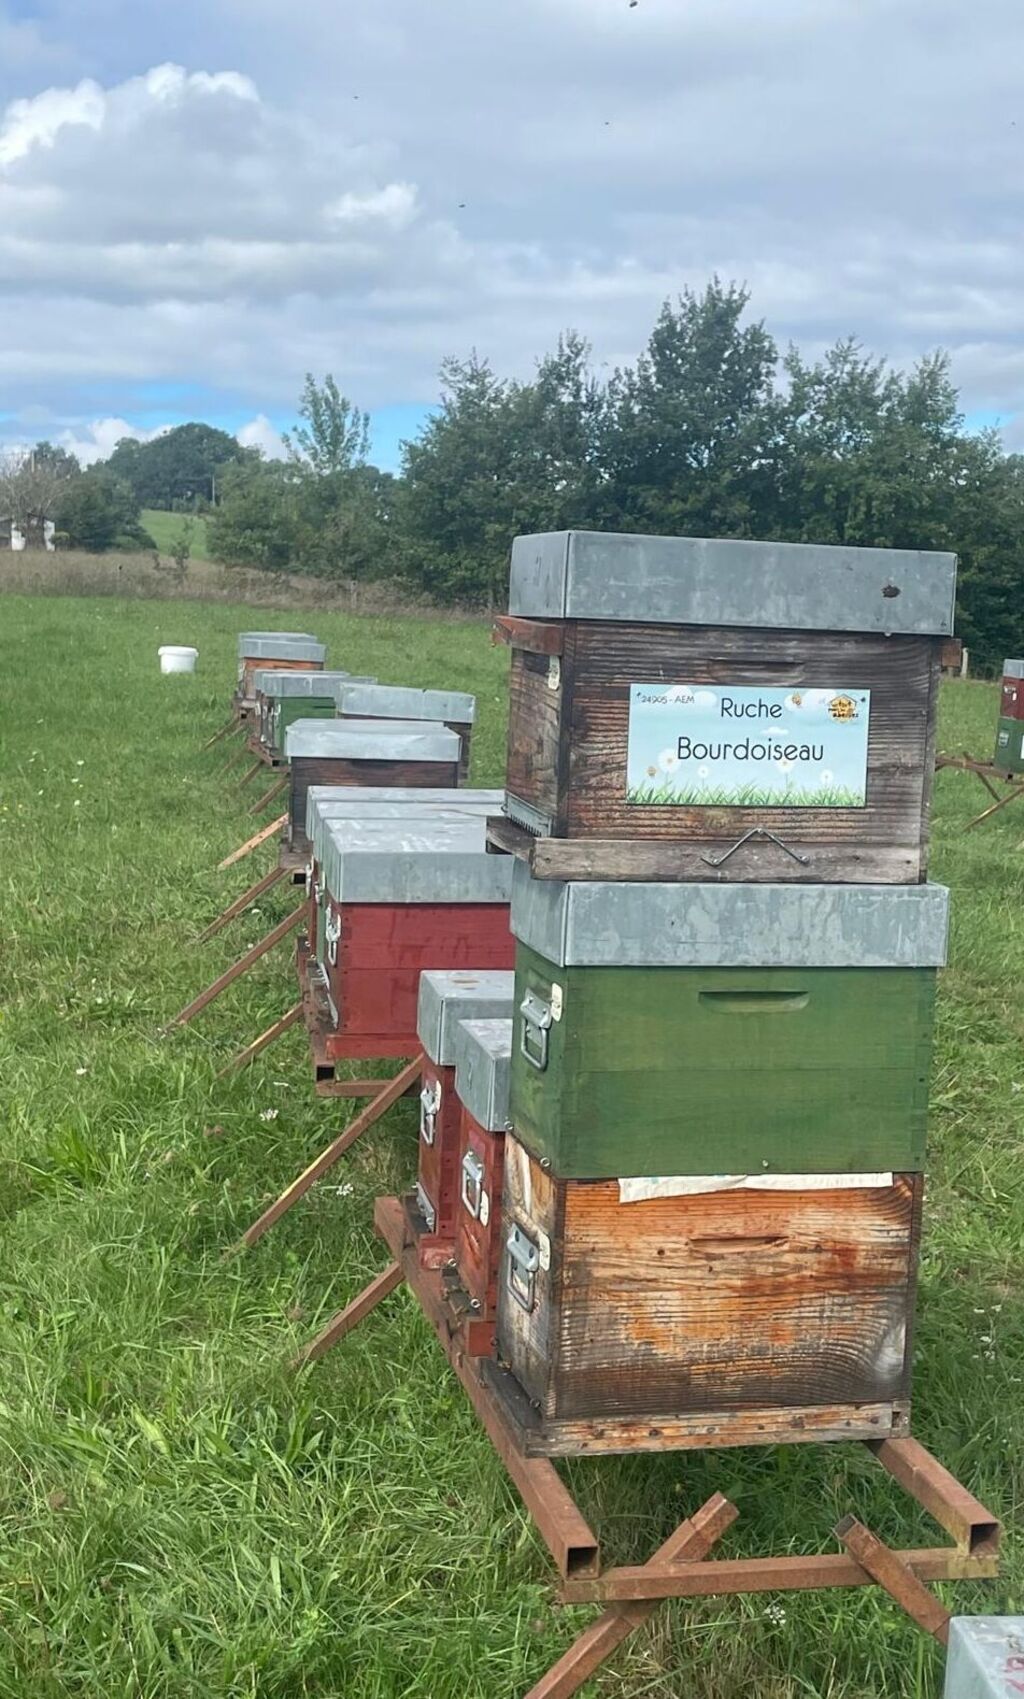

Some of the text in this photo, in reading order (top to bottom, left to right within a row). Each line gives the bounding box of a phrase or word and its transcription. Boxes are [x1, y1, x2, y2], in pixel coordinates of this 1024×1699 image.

[675, 695, 695, 704] AEM
[721, 697, 782, 718] Ruche
[677, 736, 824, 761] Bourdoiseau
